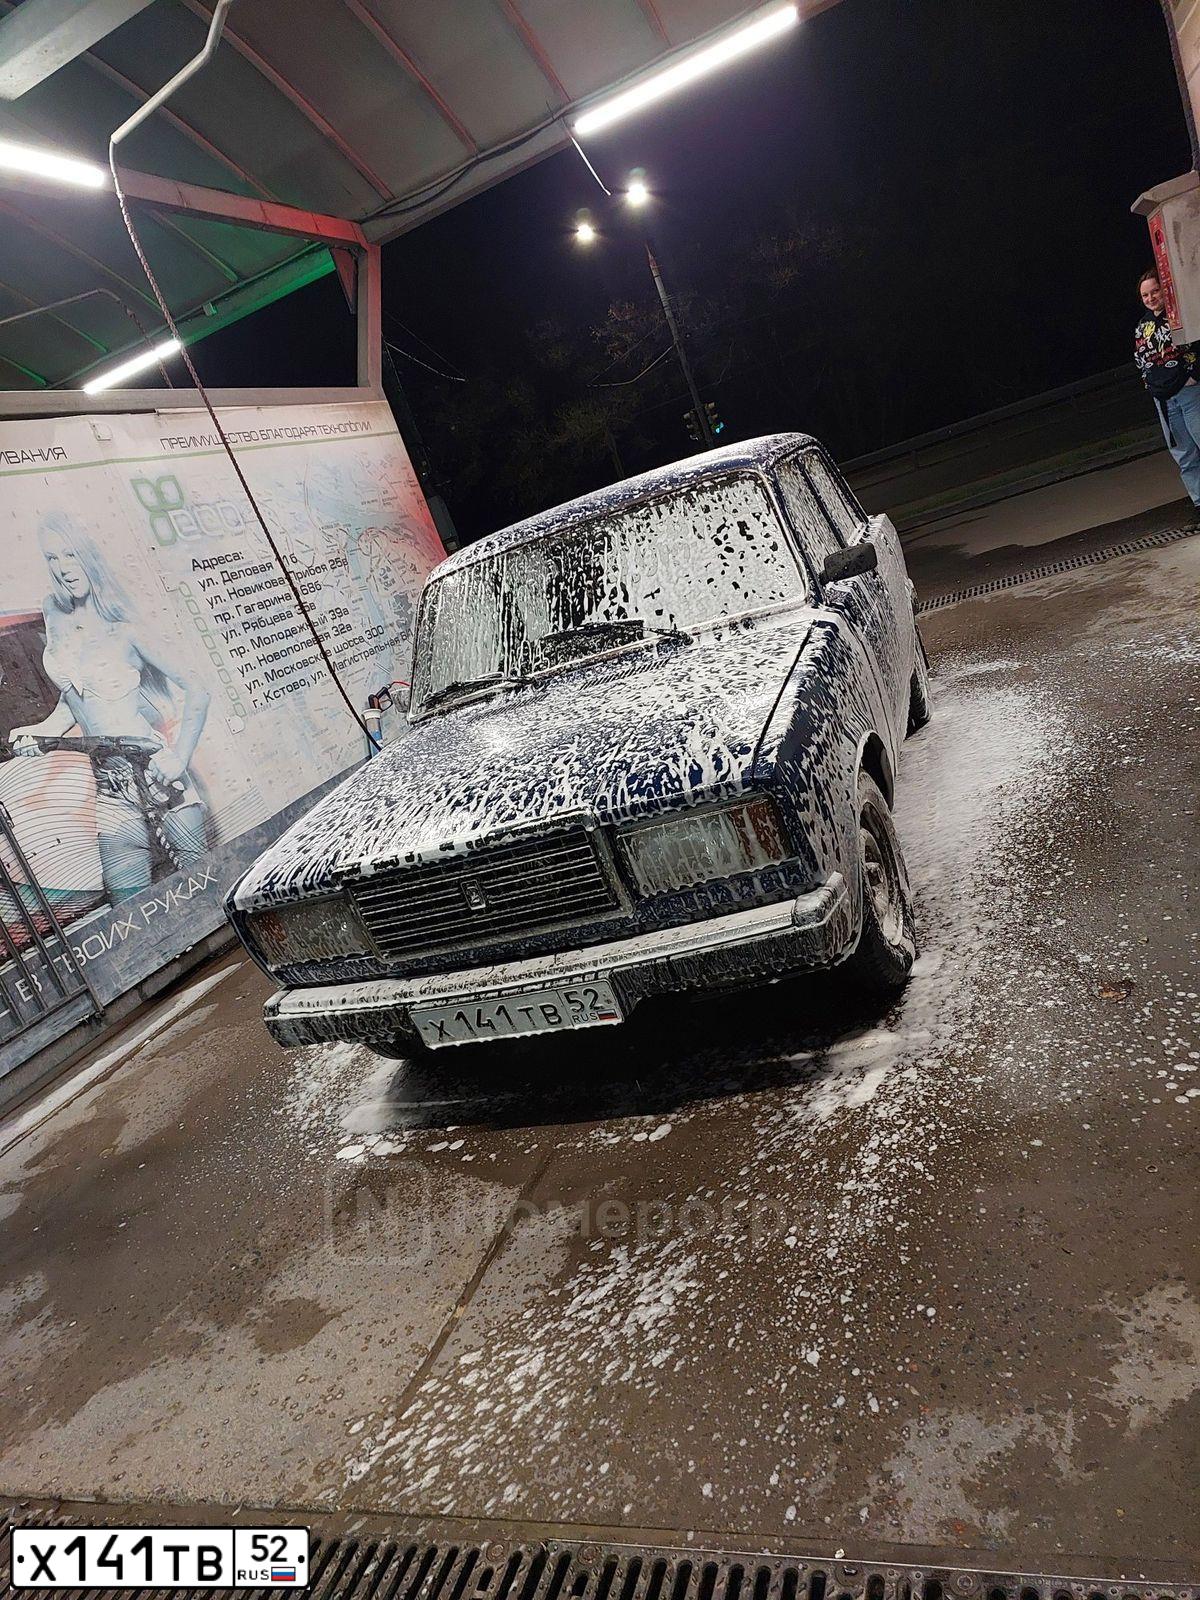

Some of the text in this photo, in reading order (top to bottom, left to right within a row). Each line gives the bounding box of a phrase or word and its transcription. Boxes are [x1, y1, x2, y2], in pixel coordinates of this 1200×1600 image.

[160, 431, 259, 450] ПРЕИМУЩЕСТВО
[259, 427, 317, 440] БЛАГОДАРЯ
[192, 551, 244, 572] Адреса:
[198, 577, 219, 592] ул.
[220, 561, 274, 585] Деловая
[206, 594, 227, 609] ул.
[214, 611, 235, 624] пр.
[235, 592, 292, 616] Гагарина
[221, 628, 241, 644] ул.
[241, 610, 293, 633] Рябцева
[229, 607, 350, 658] пр. Молодежный 39а
[237, 662, 257, 678] ул.
[256, 632, 331, 667] Новополевая
[245, 679, 264, 694] ул.
[264, 649, 333, 683] Московское
[365, 625, 385, 640] 300
[252, 699, 263, 709] г.
[263, 678, 311, 703] Кстово,
[310, 670, 327, 685] ул.
[140, 866, 219, 925] РУКАХ
[563, 988, 604, 1013] 52
[573, 1012, 599, 1024] RUS
